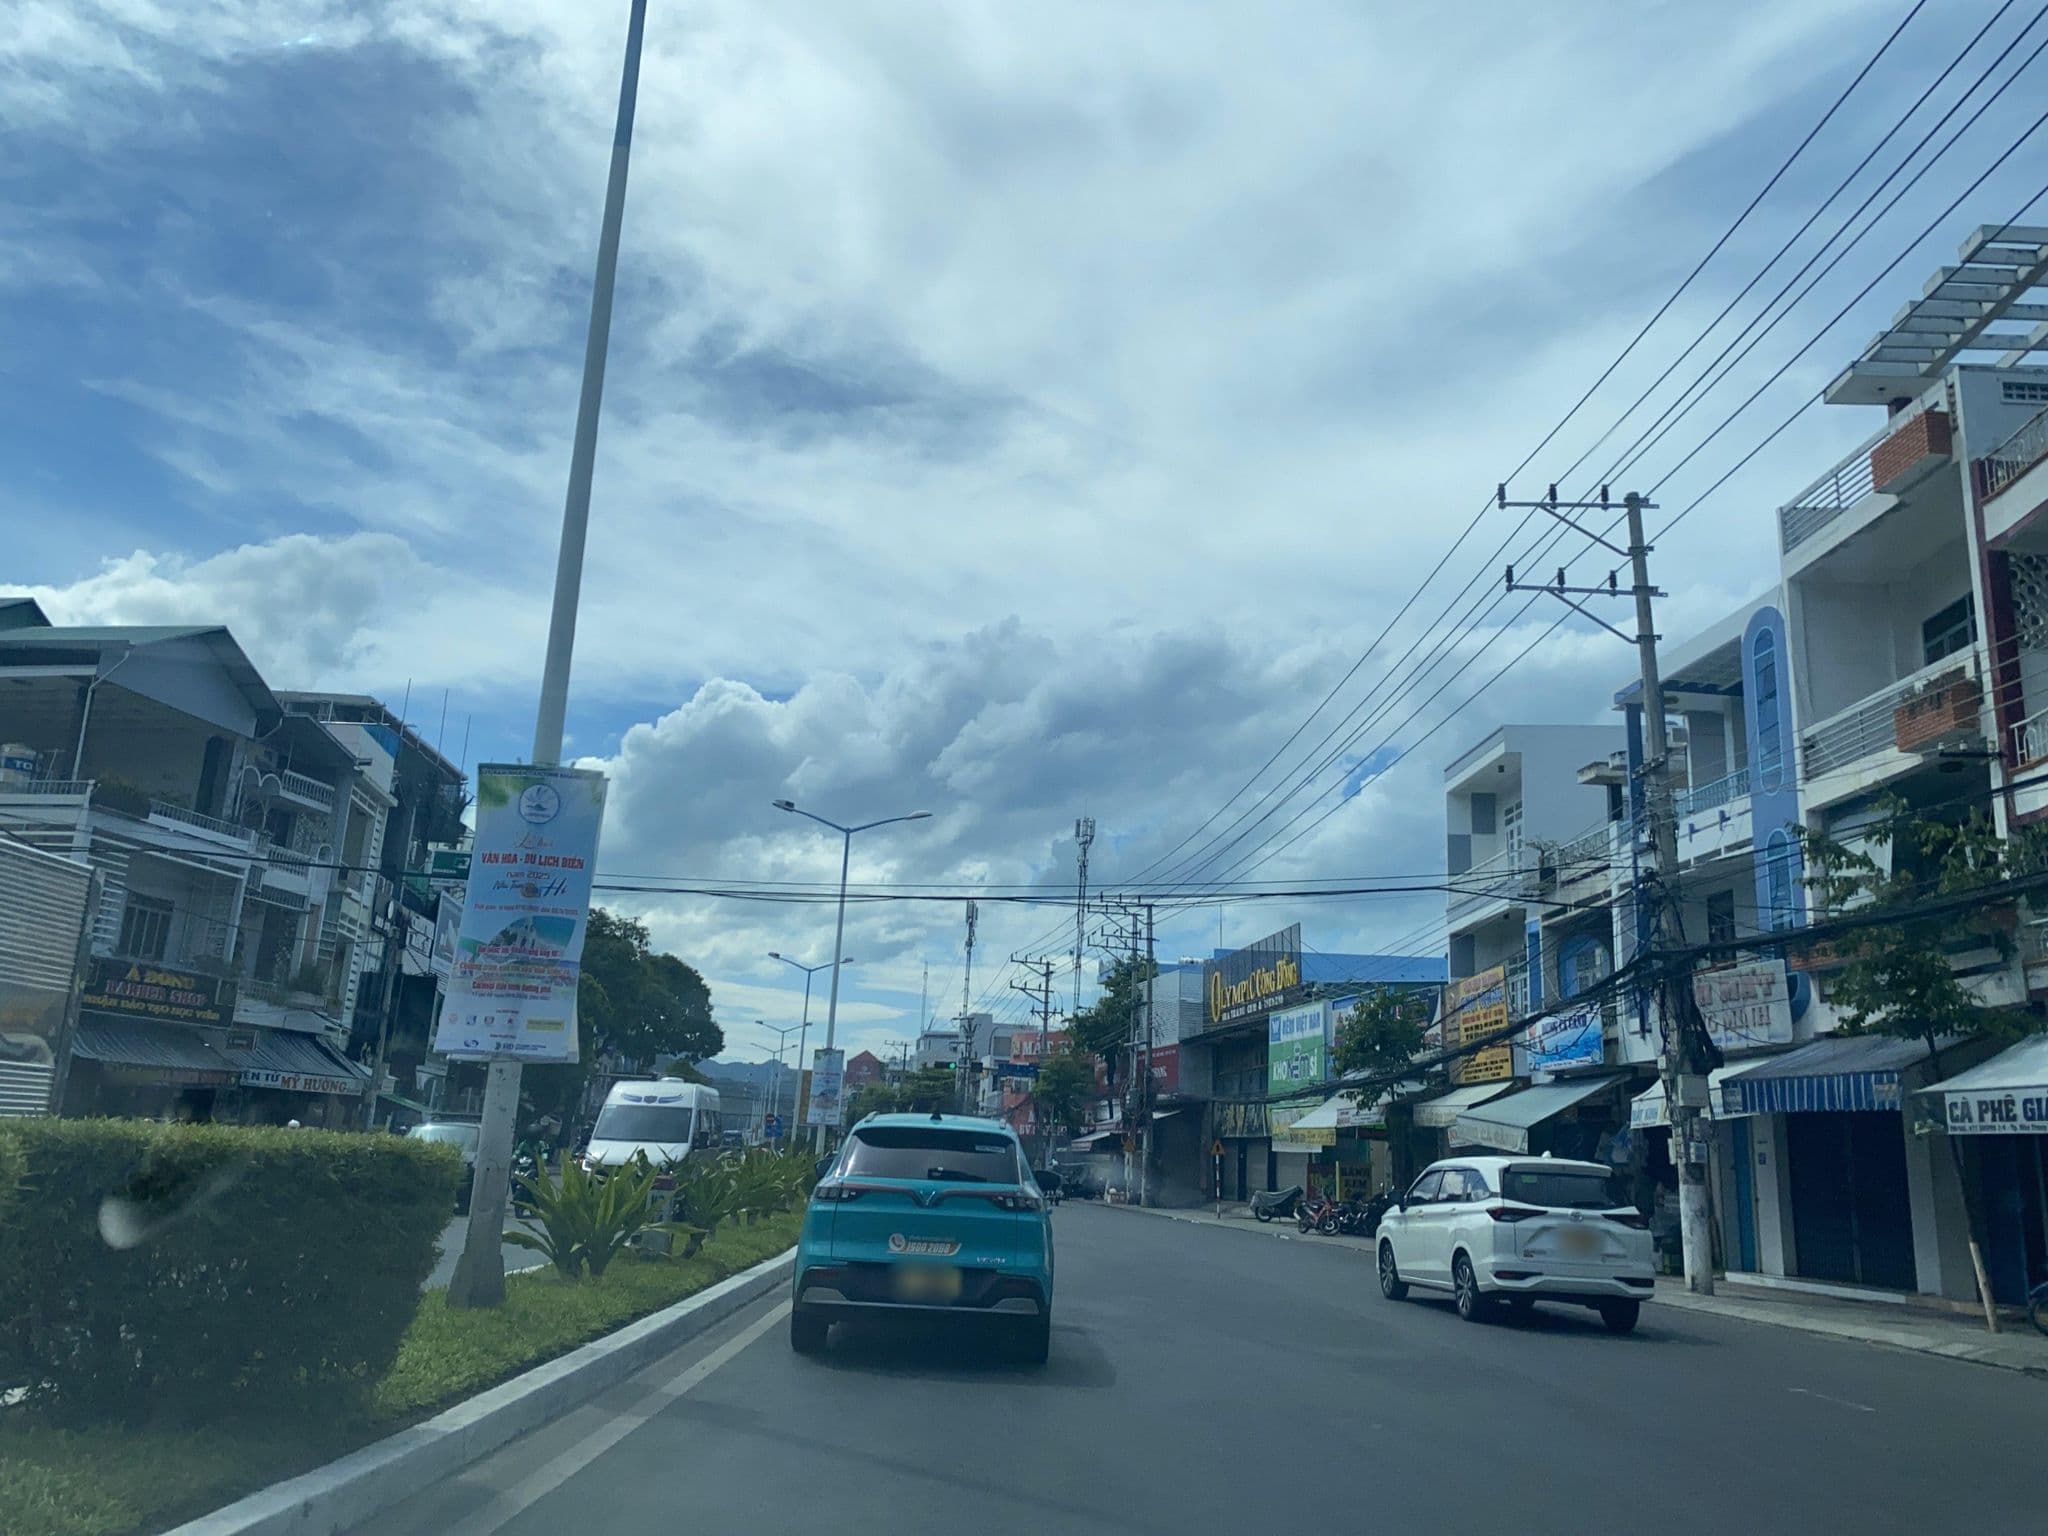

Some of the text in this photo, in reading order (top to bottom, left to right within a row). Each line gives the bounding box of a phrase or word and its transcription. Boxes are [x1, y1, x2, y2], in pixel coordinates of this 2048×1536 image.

[105, 978, 166, 1002] BARBER
[1212, 970, 1256, 1023] OLYMPIC
[1949, 1096, 1973, 1123] CÀ
[1977, 1094, 2018, 1123] PHÊ
